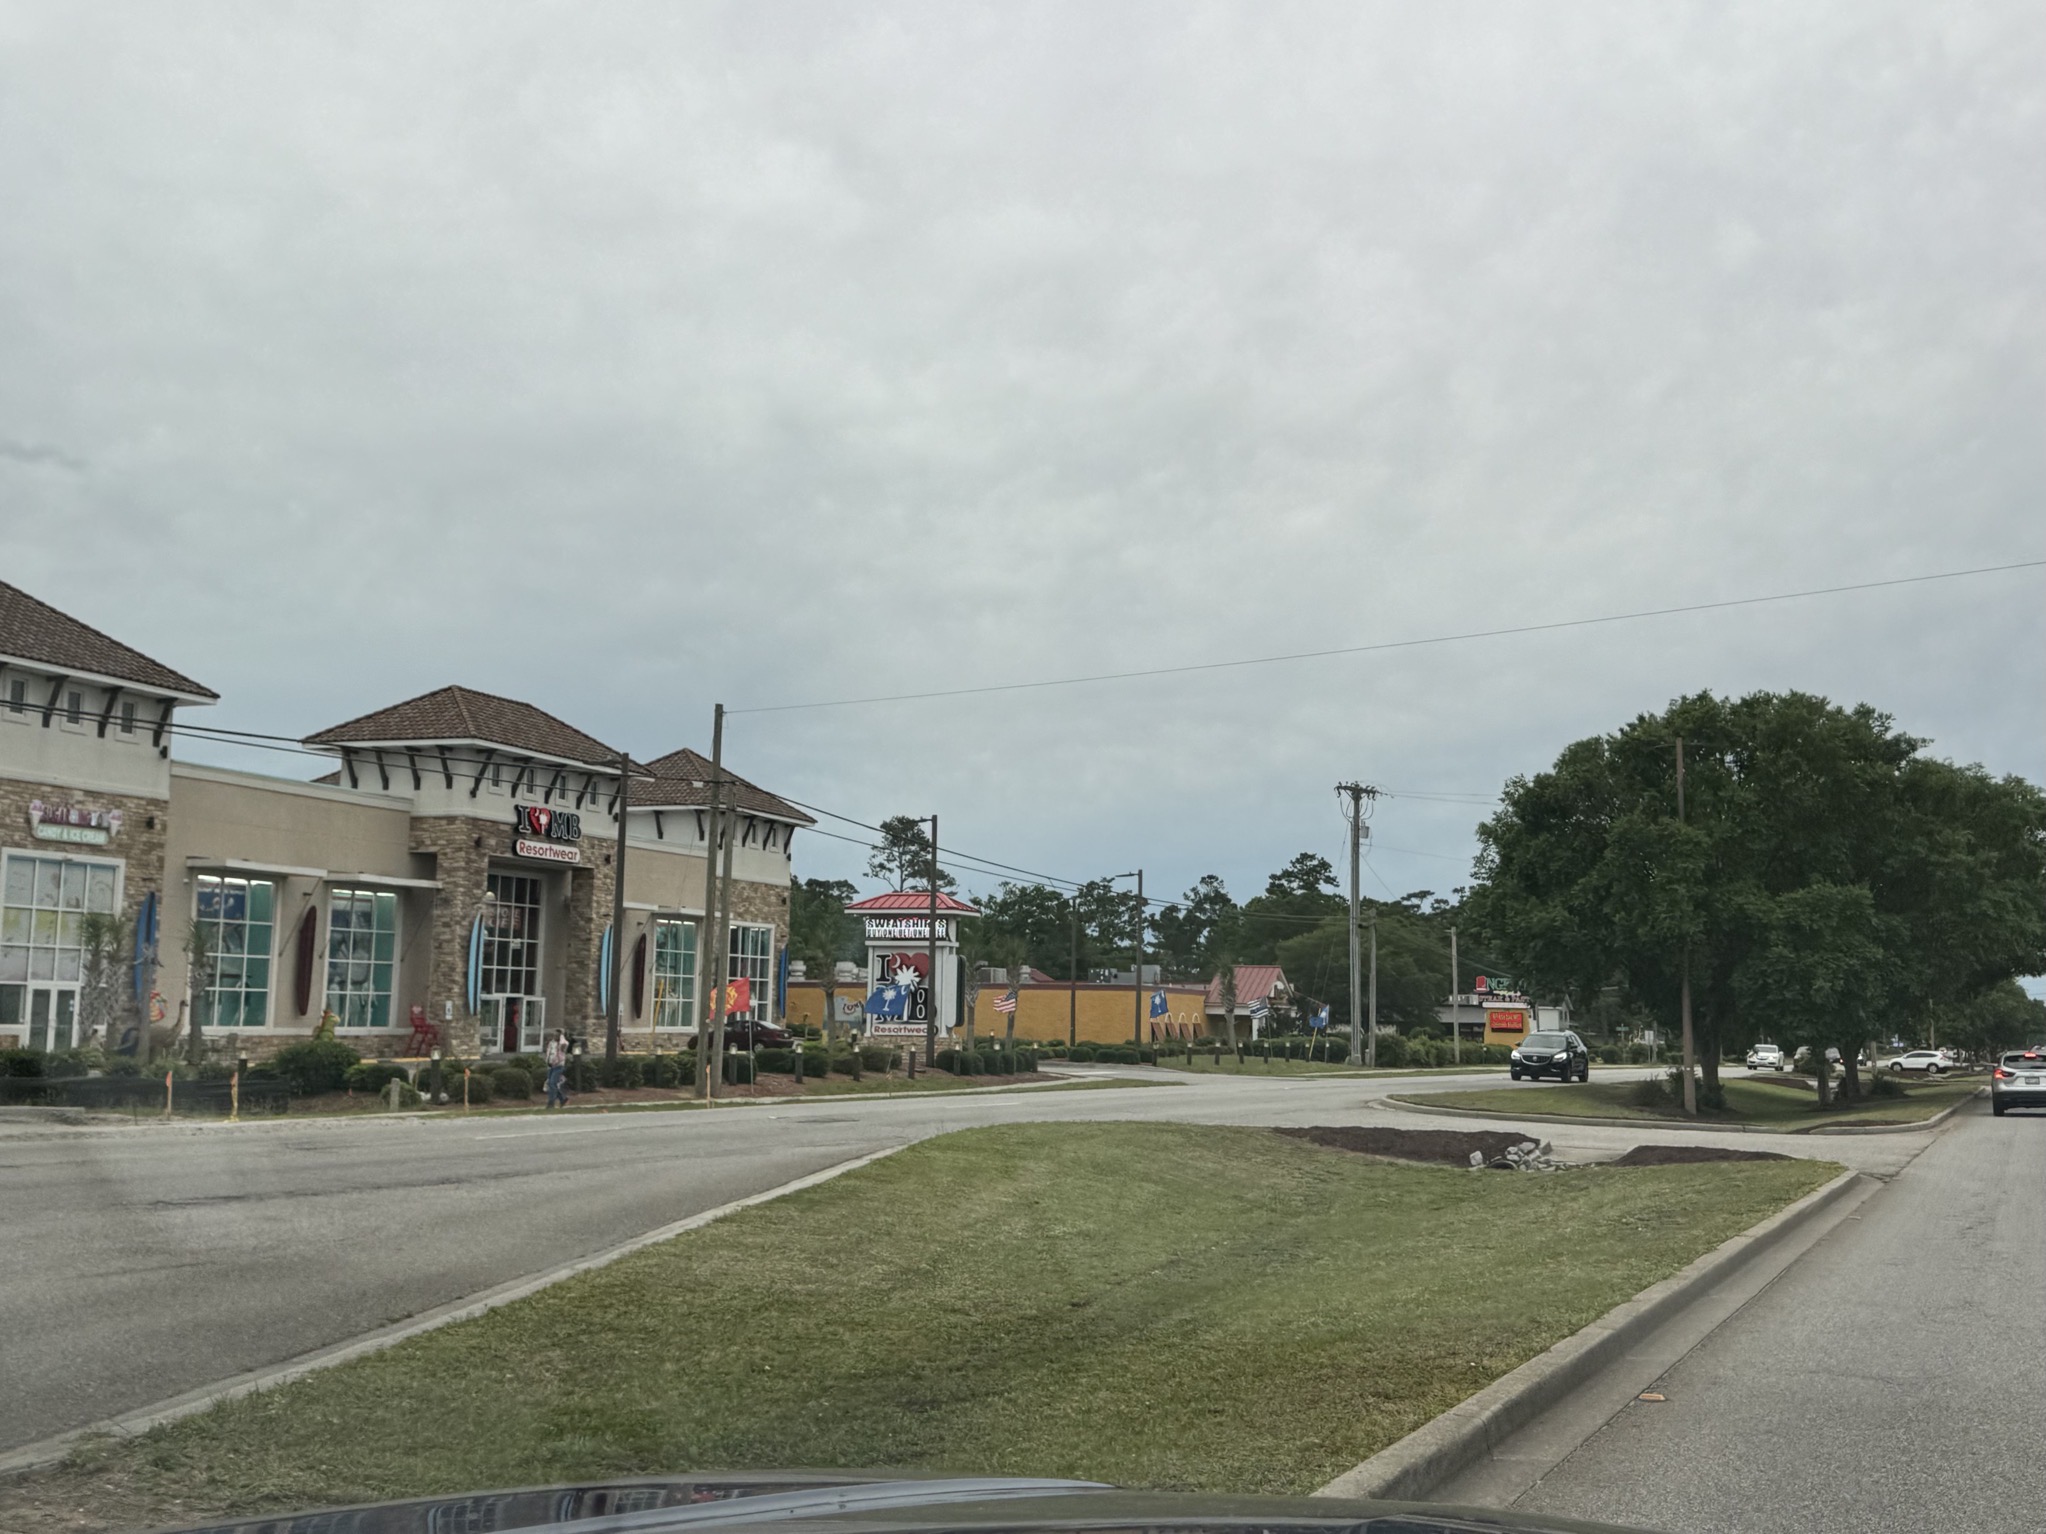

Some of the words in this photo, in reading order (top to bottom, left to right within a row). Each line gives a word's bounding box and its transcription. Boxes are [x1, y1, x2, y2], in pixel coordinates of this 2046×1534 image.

[517, 805, 531, 833] I
[551, 811, 581, 840] MB
[519, 842, 578, 861] Resortwear
[866, 919, 947, 928] SWEATSHIRS
[875, 954, 892, 983] I
[873, 1025, 931, 1035] Resortwea
